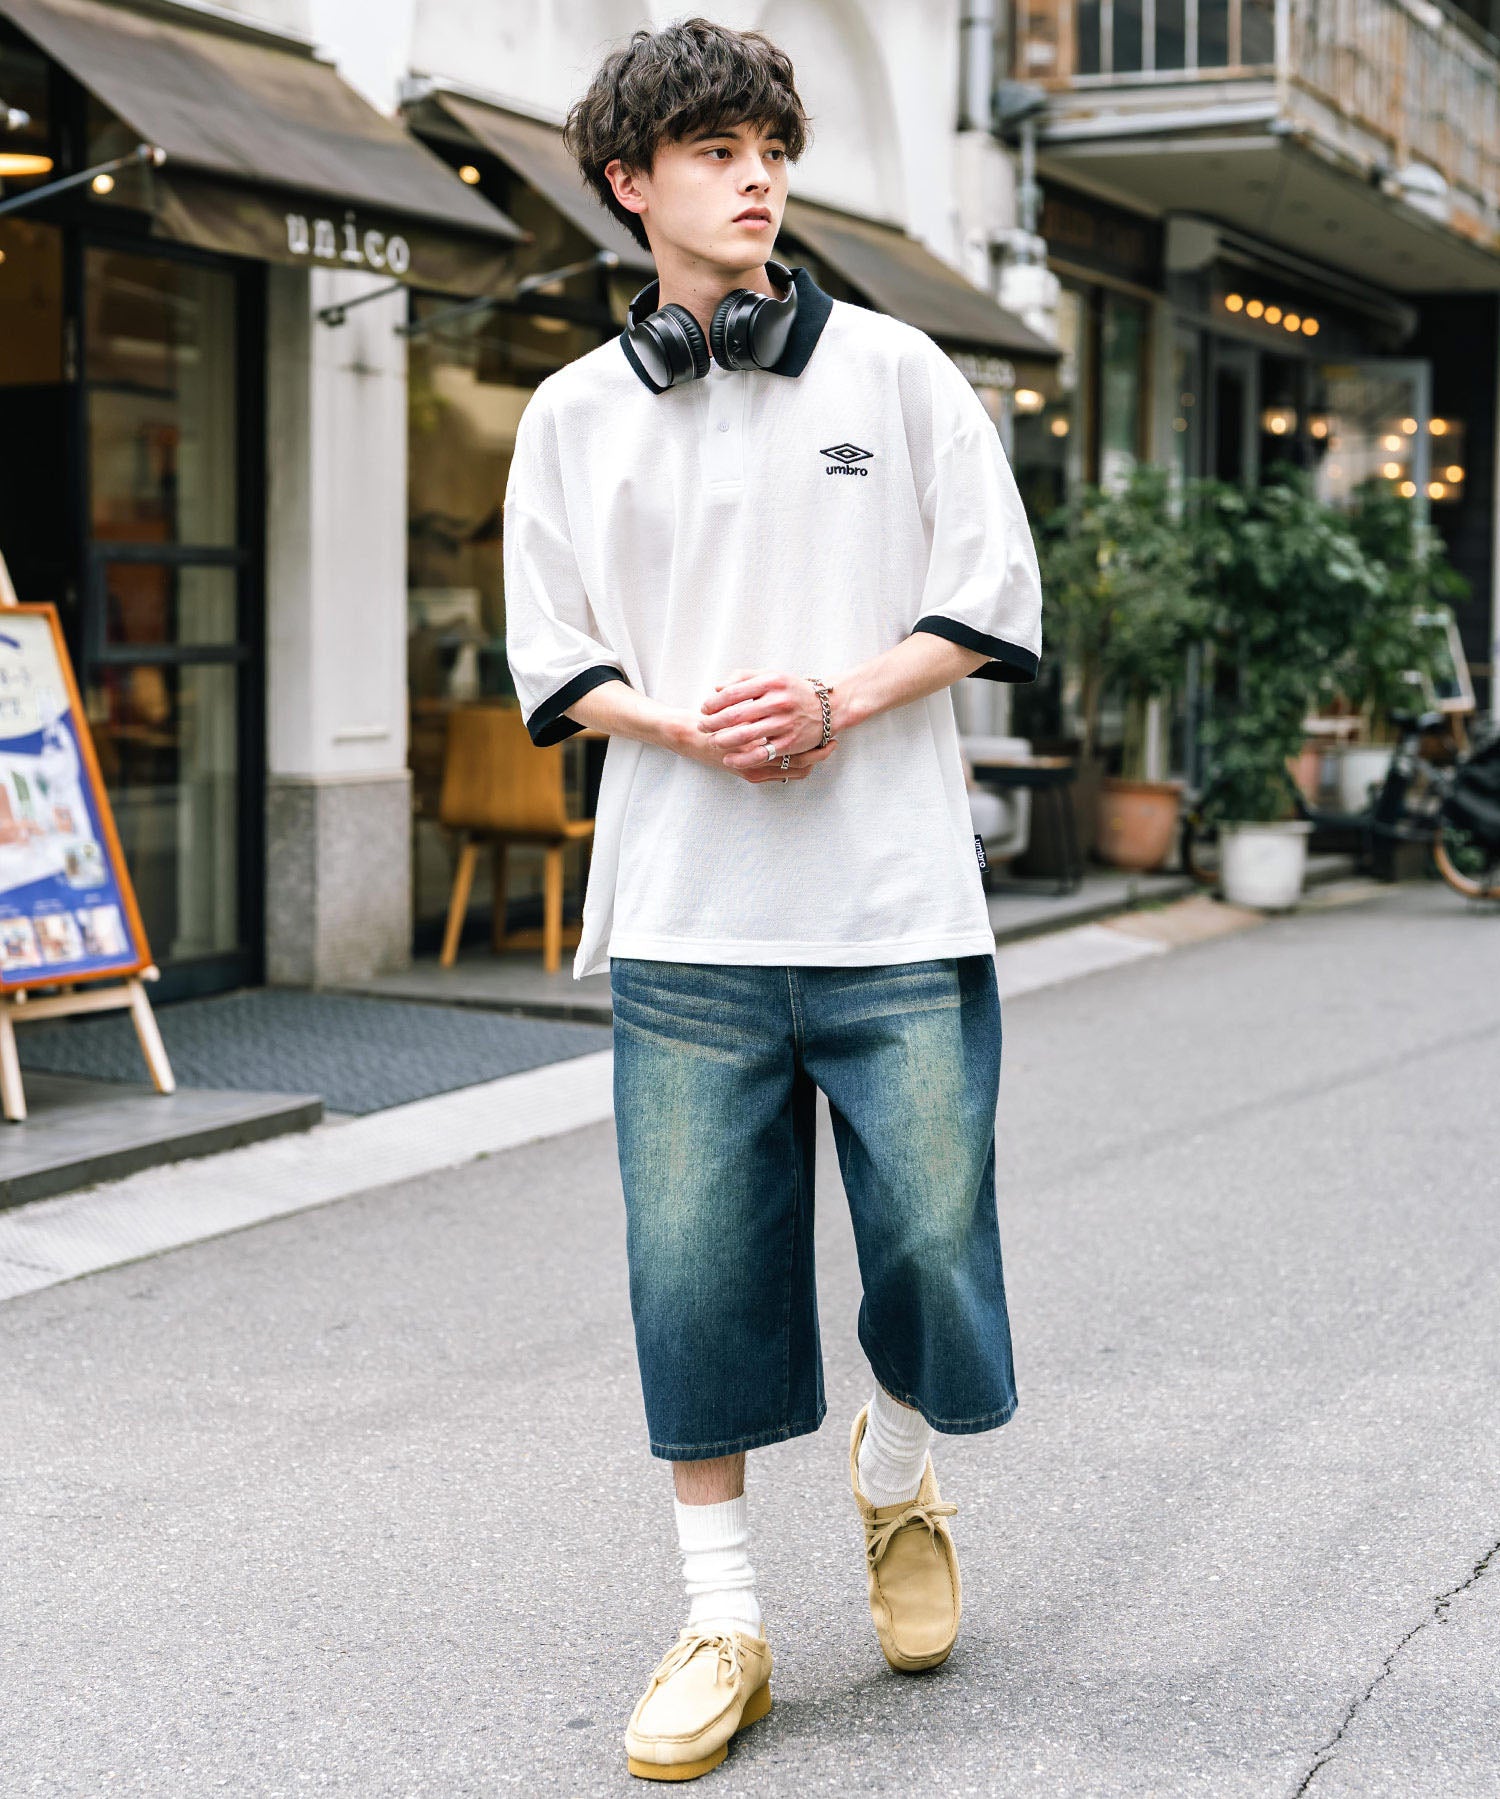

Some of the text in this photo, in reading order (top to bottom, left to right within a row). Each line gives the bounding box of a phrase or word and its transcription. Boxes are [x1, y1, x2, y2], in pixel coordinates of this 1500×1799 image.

[285, 210, 411, 274] unico
[825, 464, 868, 477] umbro
[974, 838, 986, 868] umbro
